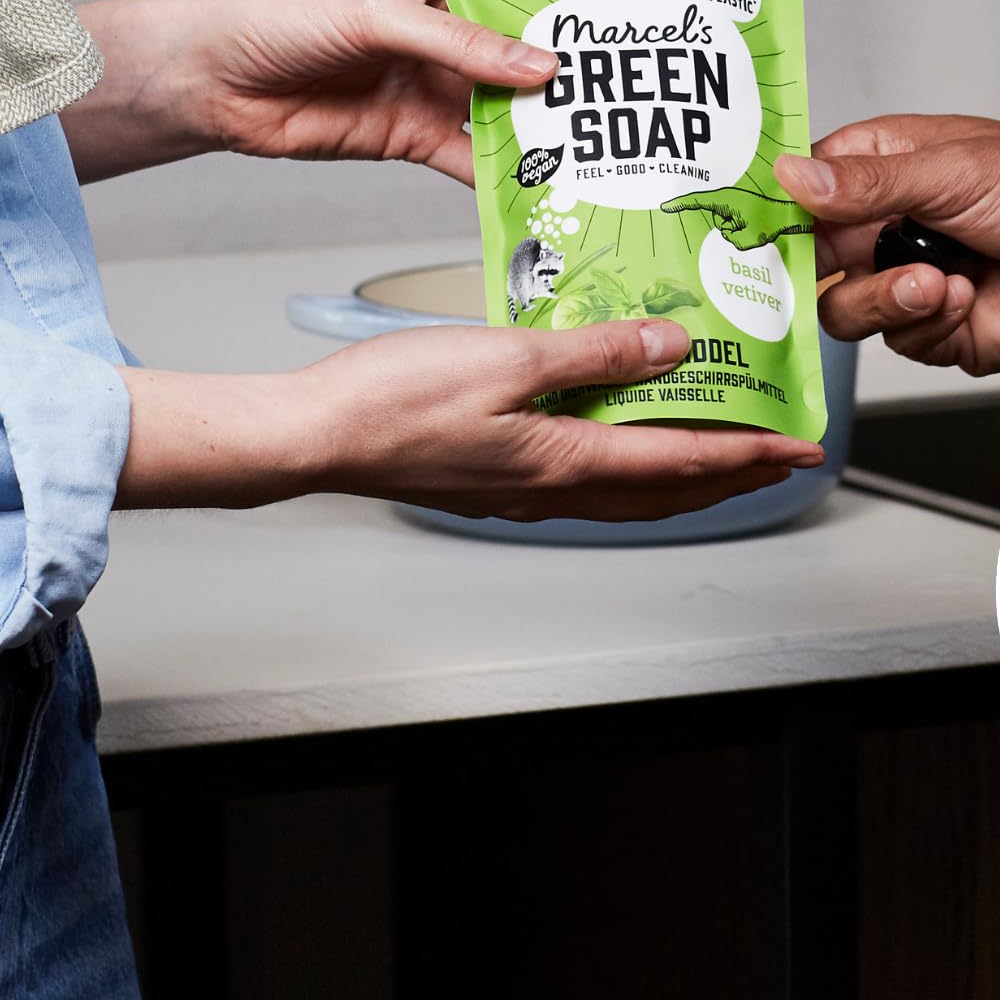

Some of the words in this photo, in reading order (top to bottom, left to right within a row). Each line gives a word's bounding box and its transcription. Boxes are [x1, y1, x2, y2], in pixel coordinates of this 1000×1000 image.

[552, 4, 712, 48] Marcel's
[545, 48, 730, 110] GREEN
[570, 107, 711, 163] SOAP
[521, 148, 549, 173] 100%
[522, 156, 558, 185] vegan
[576, 167, 604, 180] FEEL
[616, 163, 646, 176] GOOD
[659, 163, 710, 182] CLEANING
[728, 256, 772, 285] basil
[721, 280, 784, 312] vetiver
[605, 388, 654, 407] LIQUIDE
[658, 388, 726, 403] VAISSELLE
[639, 370, 788, 404] ANDGESCHIRRSPÜLMITTEL
